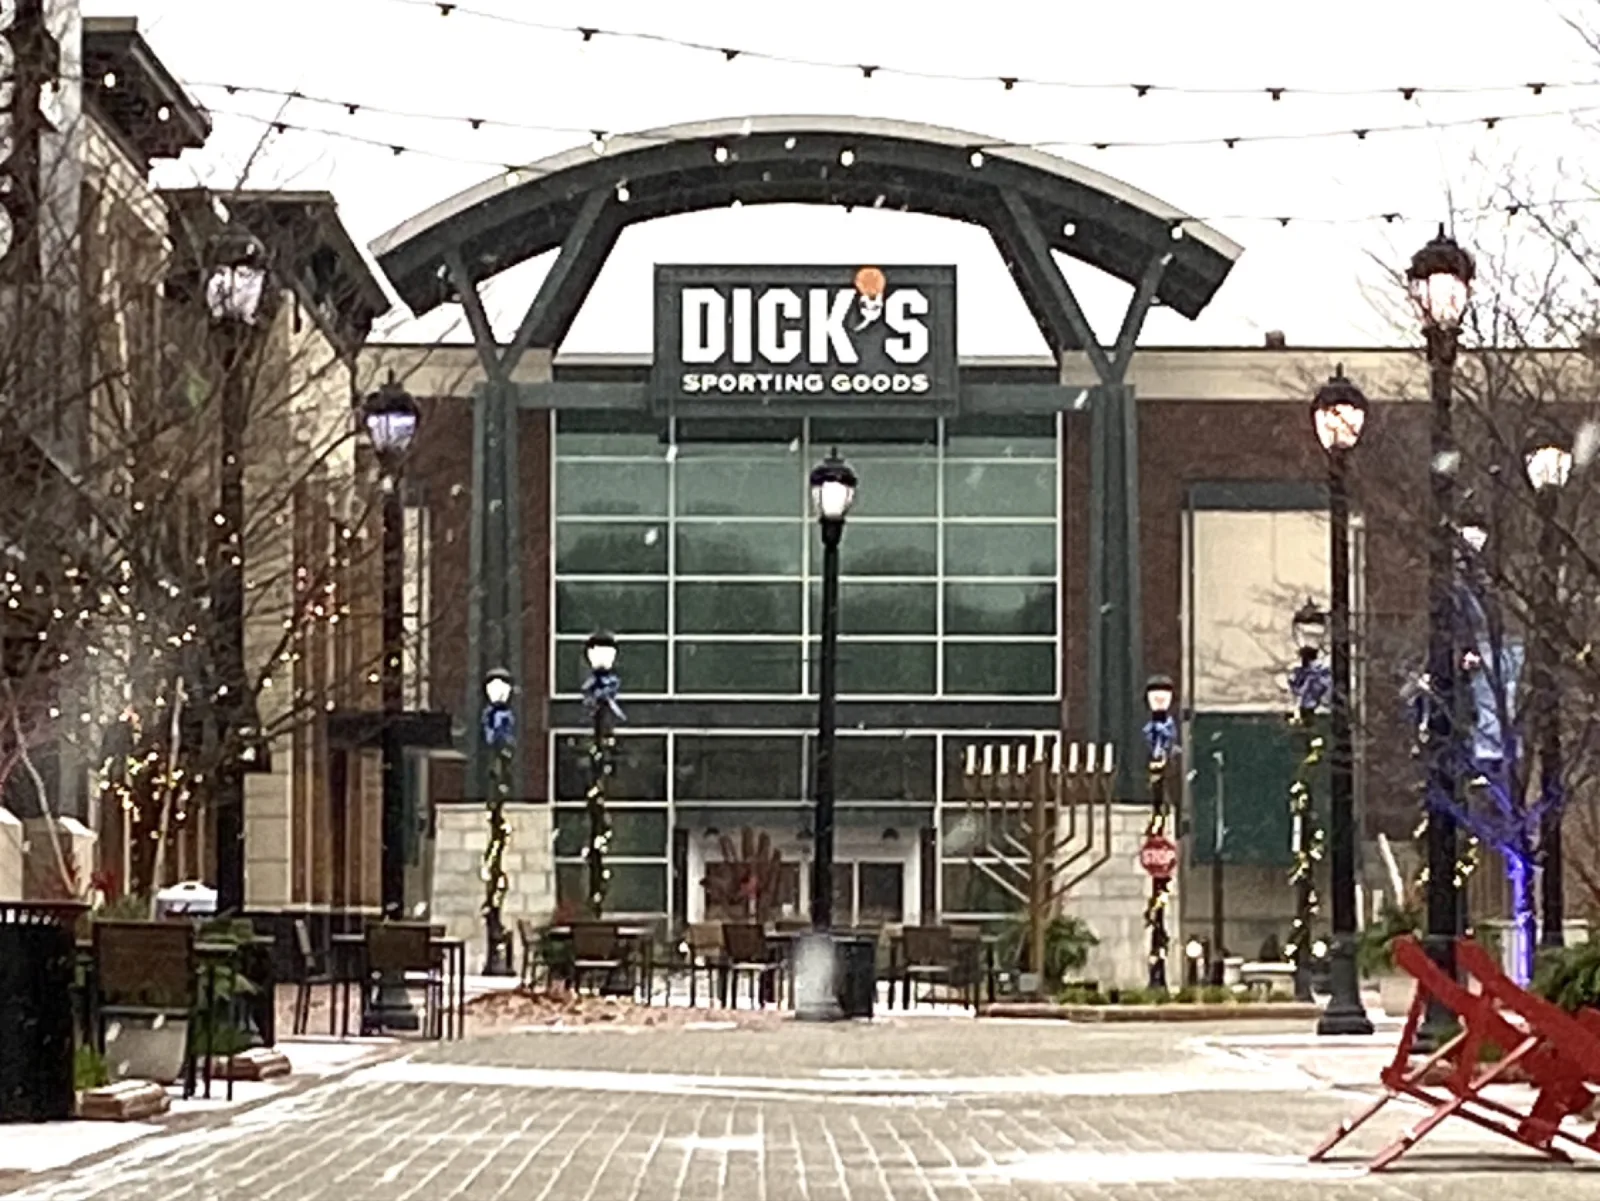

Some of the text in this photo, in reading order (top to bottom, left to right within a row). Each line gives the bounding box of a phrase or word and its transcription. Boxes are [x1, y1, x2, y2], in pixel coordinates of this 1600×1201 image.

[682, 287, 929, 364] DICK'S
[682, 373, 929, 393] SPORTING GOODS
[1141, 848, 1175, 865] STOP
